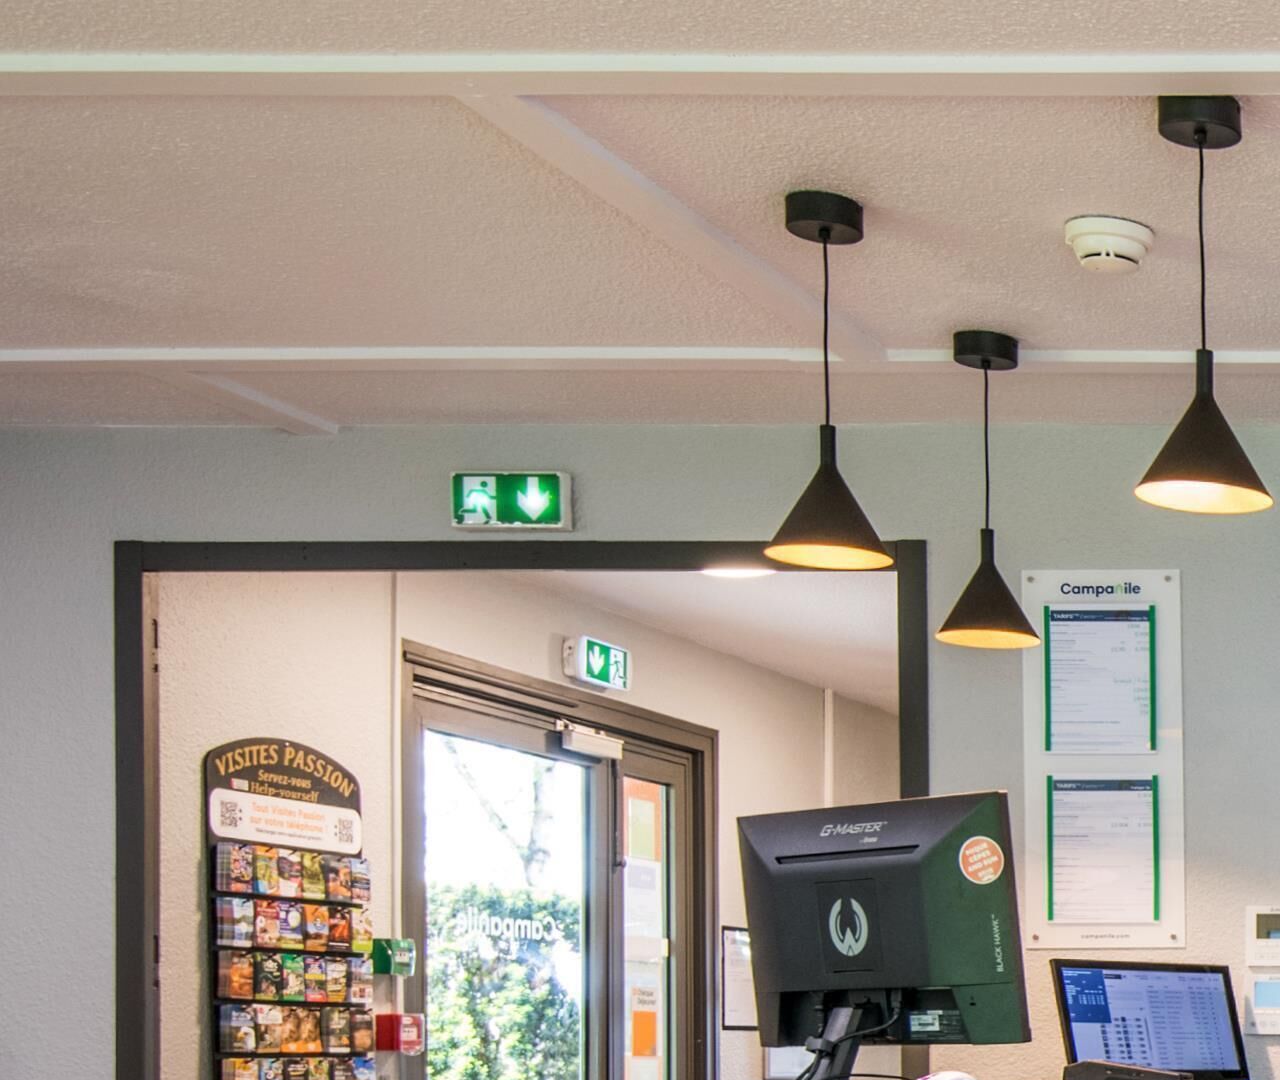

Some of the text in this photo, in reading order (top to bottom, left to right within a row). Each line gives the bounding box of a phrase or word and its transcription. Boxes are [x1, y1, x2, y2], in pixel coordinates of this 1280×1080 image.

[1060, 582, 1141, 597] Campanile
[215, 744, 355, 798] VISITES PASSION
[258, 770, 312, 789] Servez-vous
[251, 782, 320, 803] Help-yourself
[820, 822, 882, 837] G-MASTER
[992, 919, 1004, 973] BLACK HAWK
